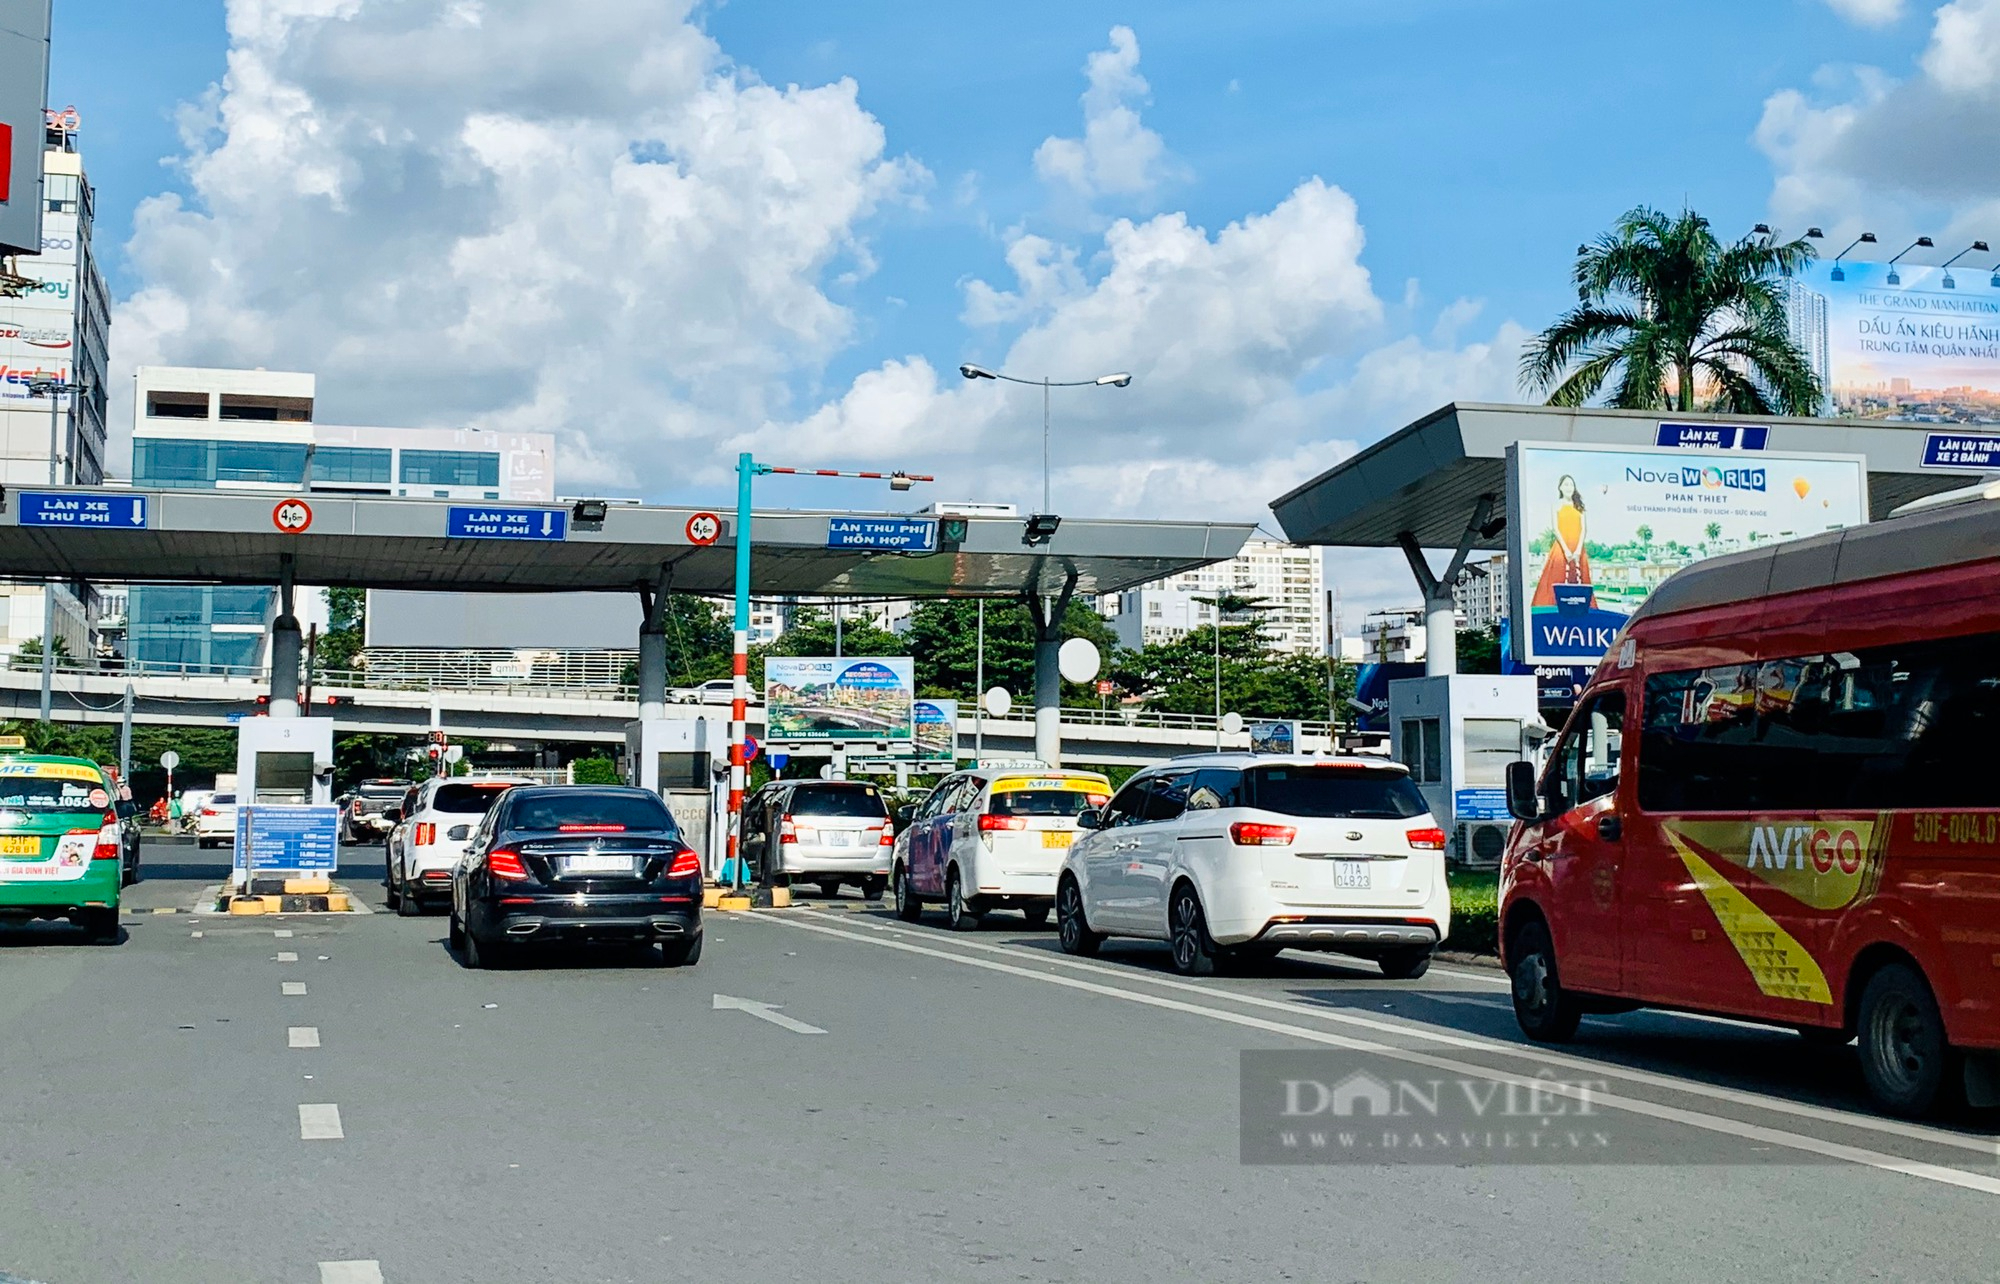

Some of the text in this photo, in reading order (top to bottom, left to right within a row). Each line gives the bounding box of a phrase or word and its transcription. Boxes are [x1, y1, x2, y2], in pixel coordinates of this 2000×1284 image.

[1859, 293, 1998, 313] THE GRAND MANHATTAN
[1859, 316, 1891, 335] DẤU
[1896, 317, 1916, 336] ẤN
[1860, 340, 1900, 353] TRUNG
[1905, 342, 1928, 355] TÂM
[1932, 343, 1965, 358] QUẬN
[1680, 428, 1719, 442] LÀN XE
[1938, 438, 1960, 451] LÀN
[1936, 450, 1990, 463] XE 2 BÁNH
[1665, 493, 1728, 503] PHAN THIET
[43, 498, 109, 511] LÀN XE
[38, 512, 110, 522] THU PHÍ
[469, 512, 528, 523] LÀN XE
[463, 525, 530, 534] THU PHÍ
[831, 522, 925, 534] LÀN THU PHÍ
[843, 533, 910, 546] HỖN HỢP
[1028, 780, 1063, 788] MPE
[58, 797, 91, 807] 1055
[1343, 863, 1360, 875] 71A
